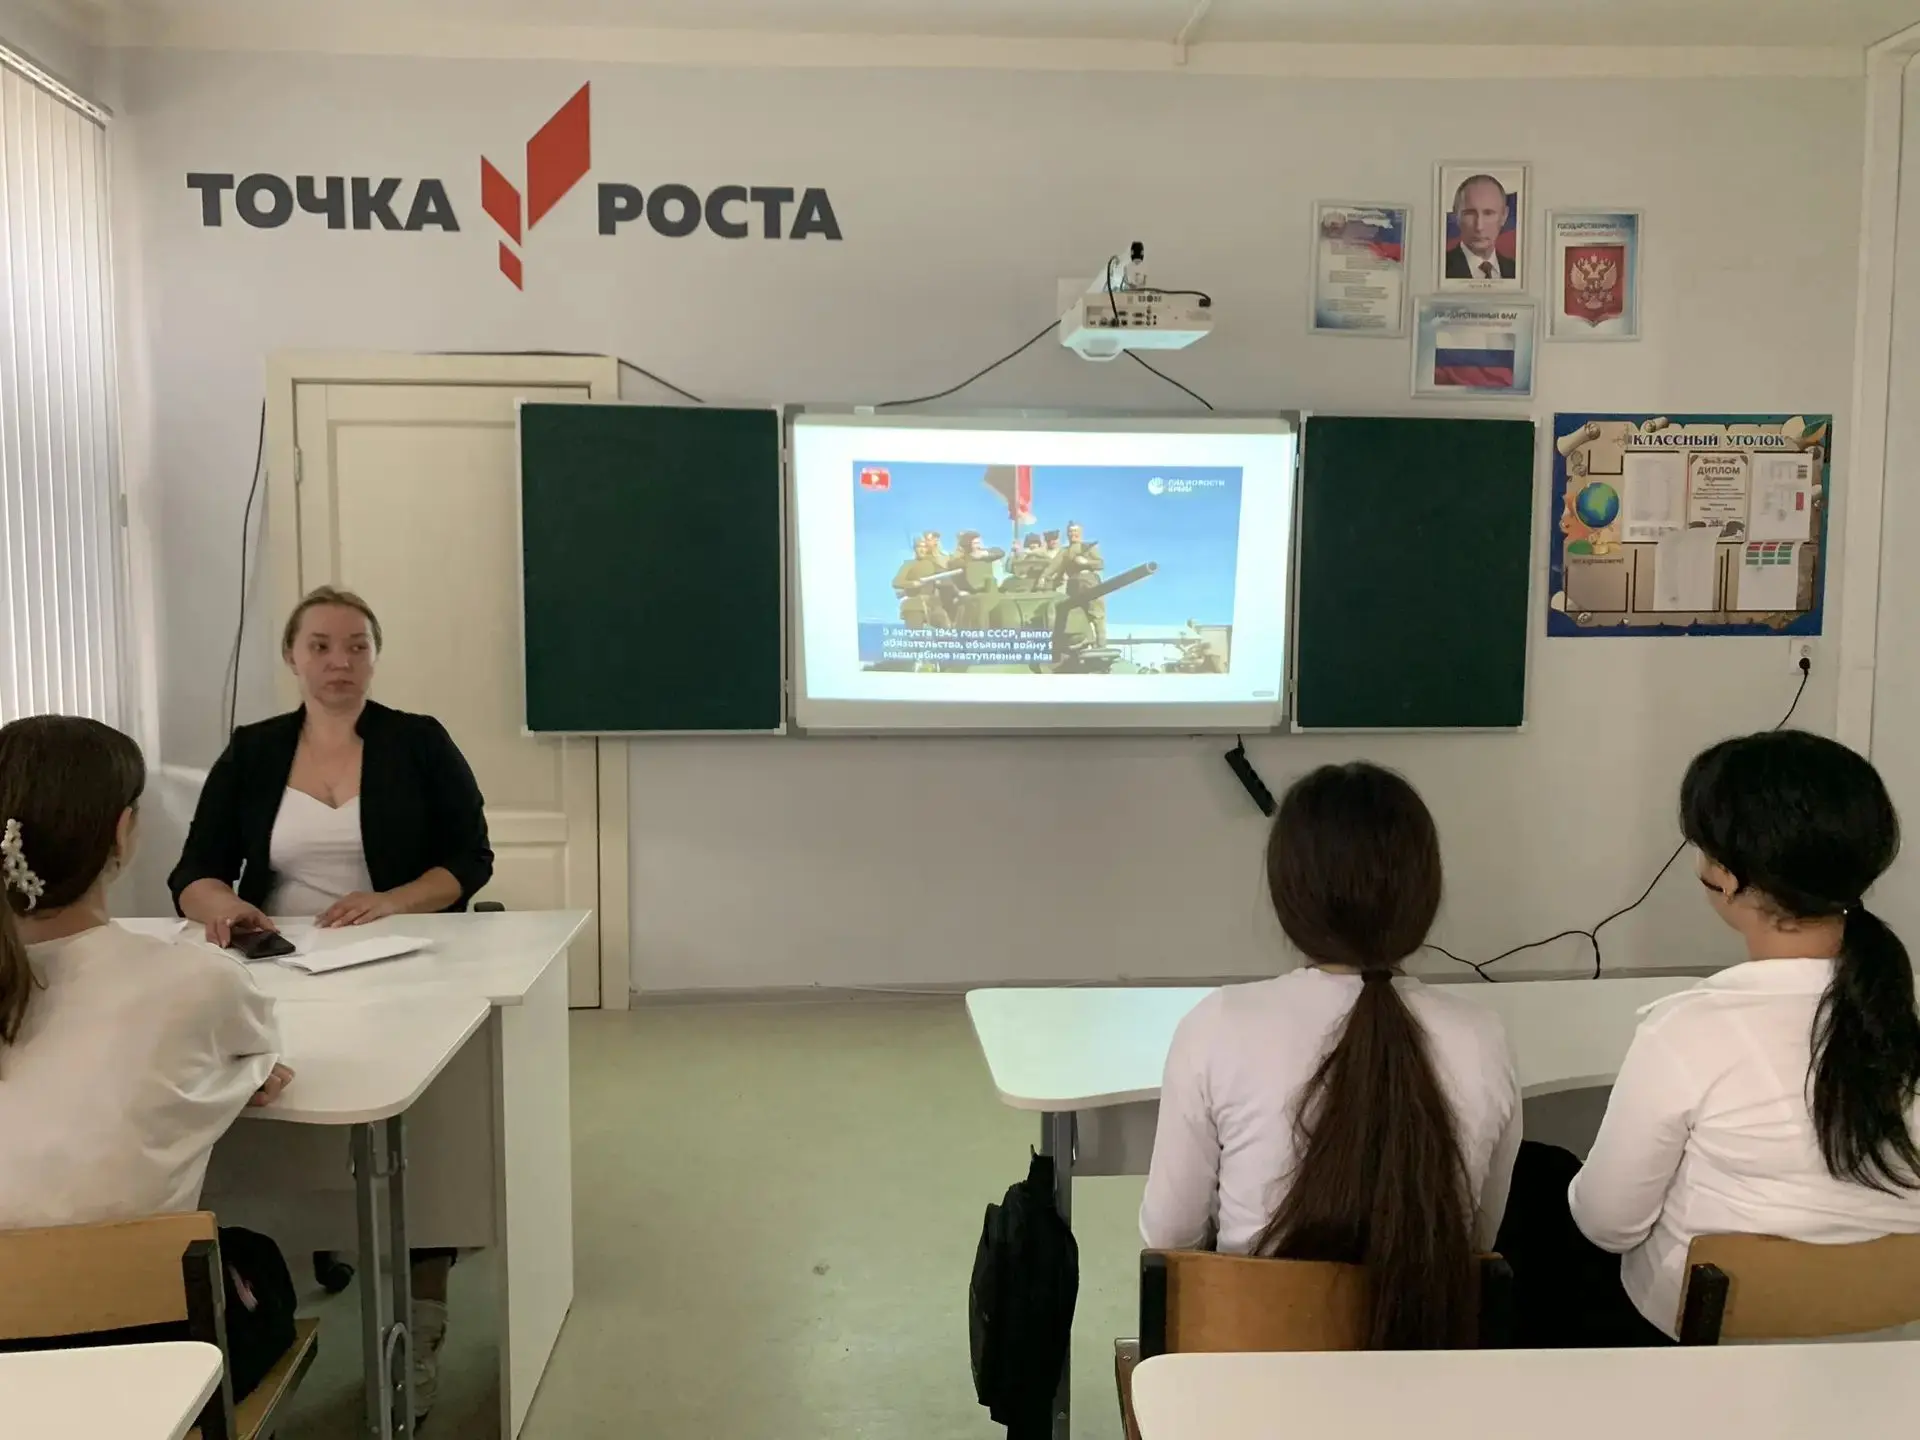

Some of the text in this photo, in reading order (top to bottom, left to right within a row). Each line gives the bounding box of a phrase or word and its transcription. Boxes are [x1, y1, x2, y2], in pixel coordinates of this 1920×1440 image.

[186, 171, 461, 232] ТОЧКА
[597, 182, 844, 241] РОСТА
[1632, 433, 1785, 447] КЛАССНЫЙ УГОЛОК
[1696, 467, 1741, 475] ДИПЛОМ
[935, 628, 958, 638] 1945
[1013, 640, 1046, 650] войну
[952, 652, 1022, 661] наступление
